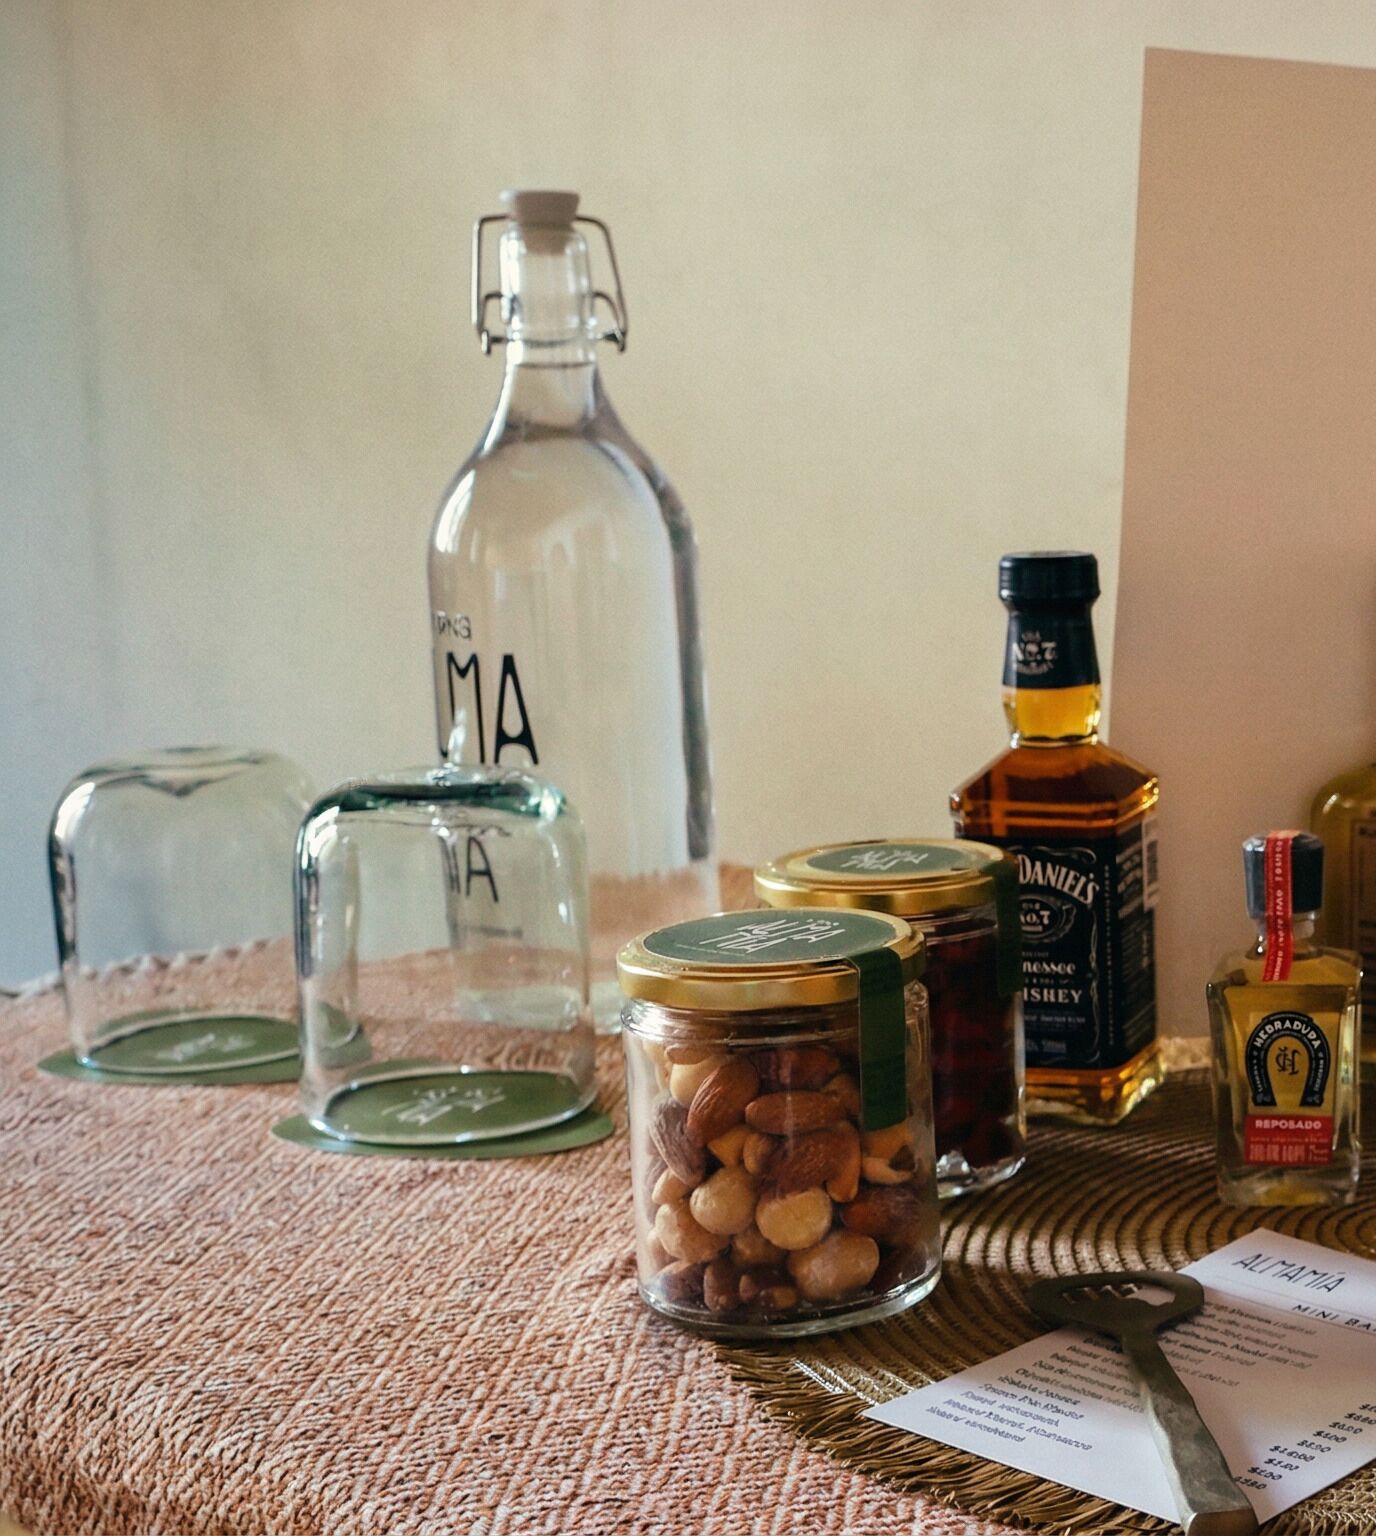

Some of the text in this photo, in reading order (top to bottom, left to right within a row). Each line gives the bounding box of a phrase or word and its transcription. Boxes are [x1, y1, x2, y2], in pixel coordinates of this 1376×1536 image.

[1255, 1119, 1322, 1130] REPOSADO
[1231, 1252, 1348, 1294] ALMAMÍA
[1292, 1303, 1337, 1321] MINI
